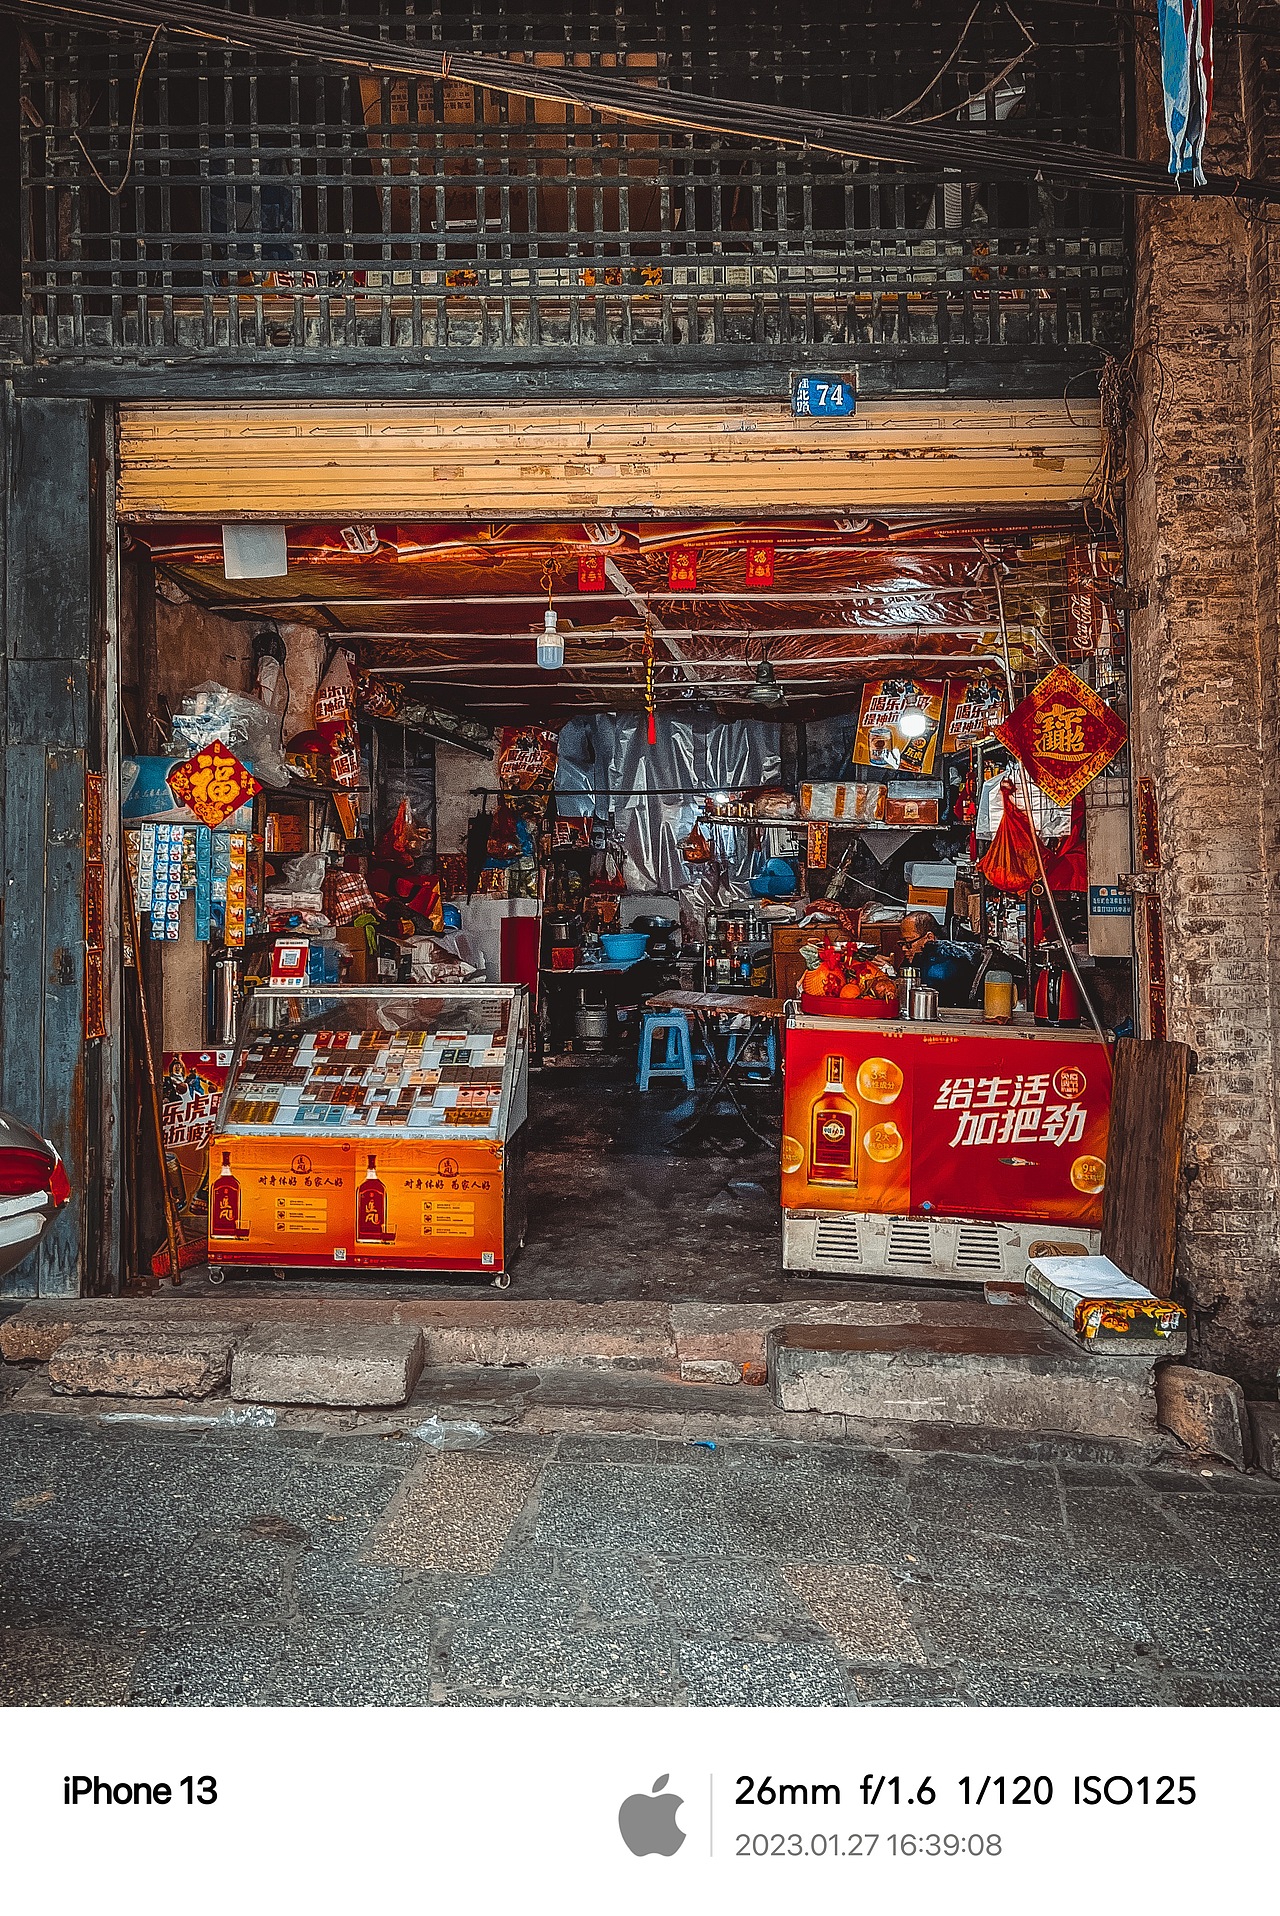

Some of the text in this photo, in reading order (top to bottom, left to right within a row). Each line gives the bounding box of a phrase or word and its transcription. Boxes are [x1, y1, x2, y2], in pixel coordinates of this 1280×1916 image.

[816, 384, 843, 406] 74
[190, 754, 241, 805] 福
[933, 1073, 1050, 1110] 给生活
[948, 1102, 1088, 1148] 加把劲
